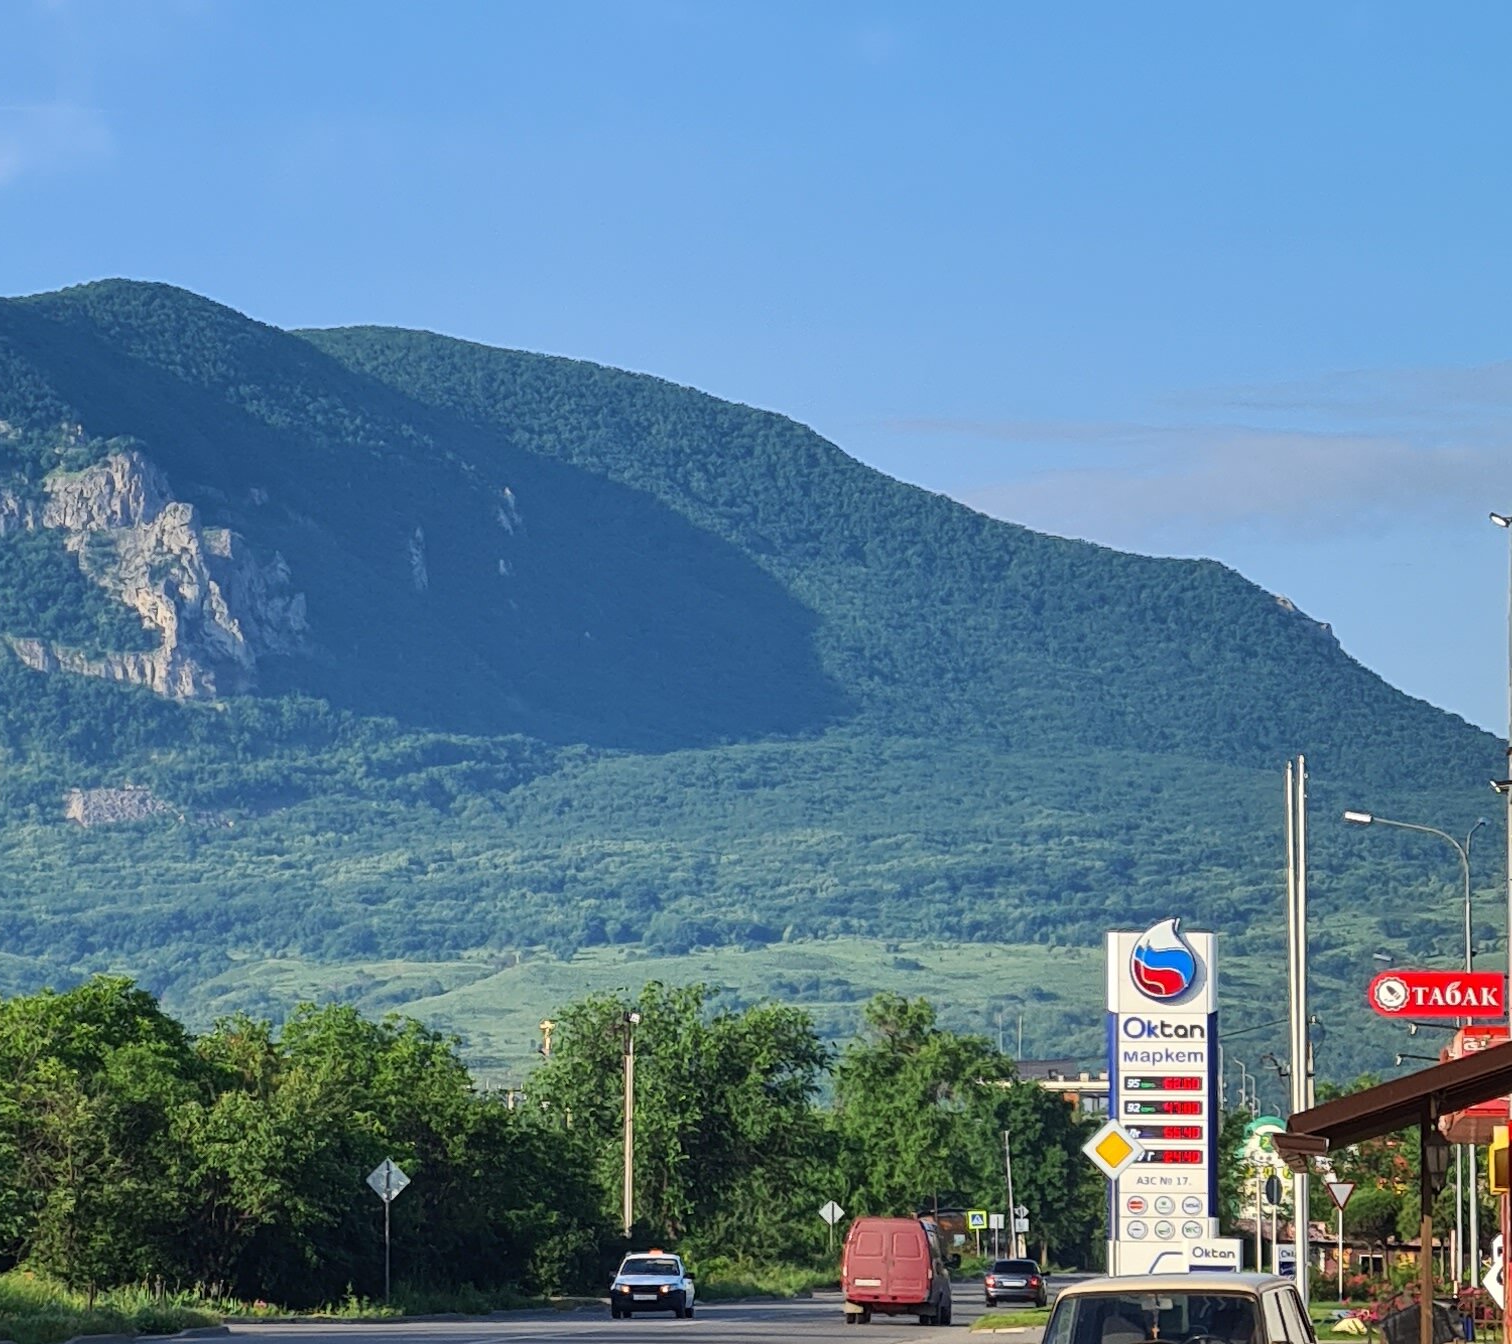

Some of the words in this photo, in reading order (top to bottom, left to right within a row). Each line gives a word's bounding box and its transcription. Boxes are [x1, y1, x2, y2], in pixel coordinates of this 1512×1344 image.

[1123, 1017, 1205, 1039] Oktan
[1127, 1078, 1141, 1088] 95
[1127, 1103, 1141, 1113] 92
[1136, 1177, 1158, 1185] АЗС
[1192, 1246, 1236, 1258] Oktan
